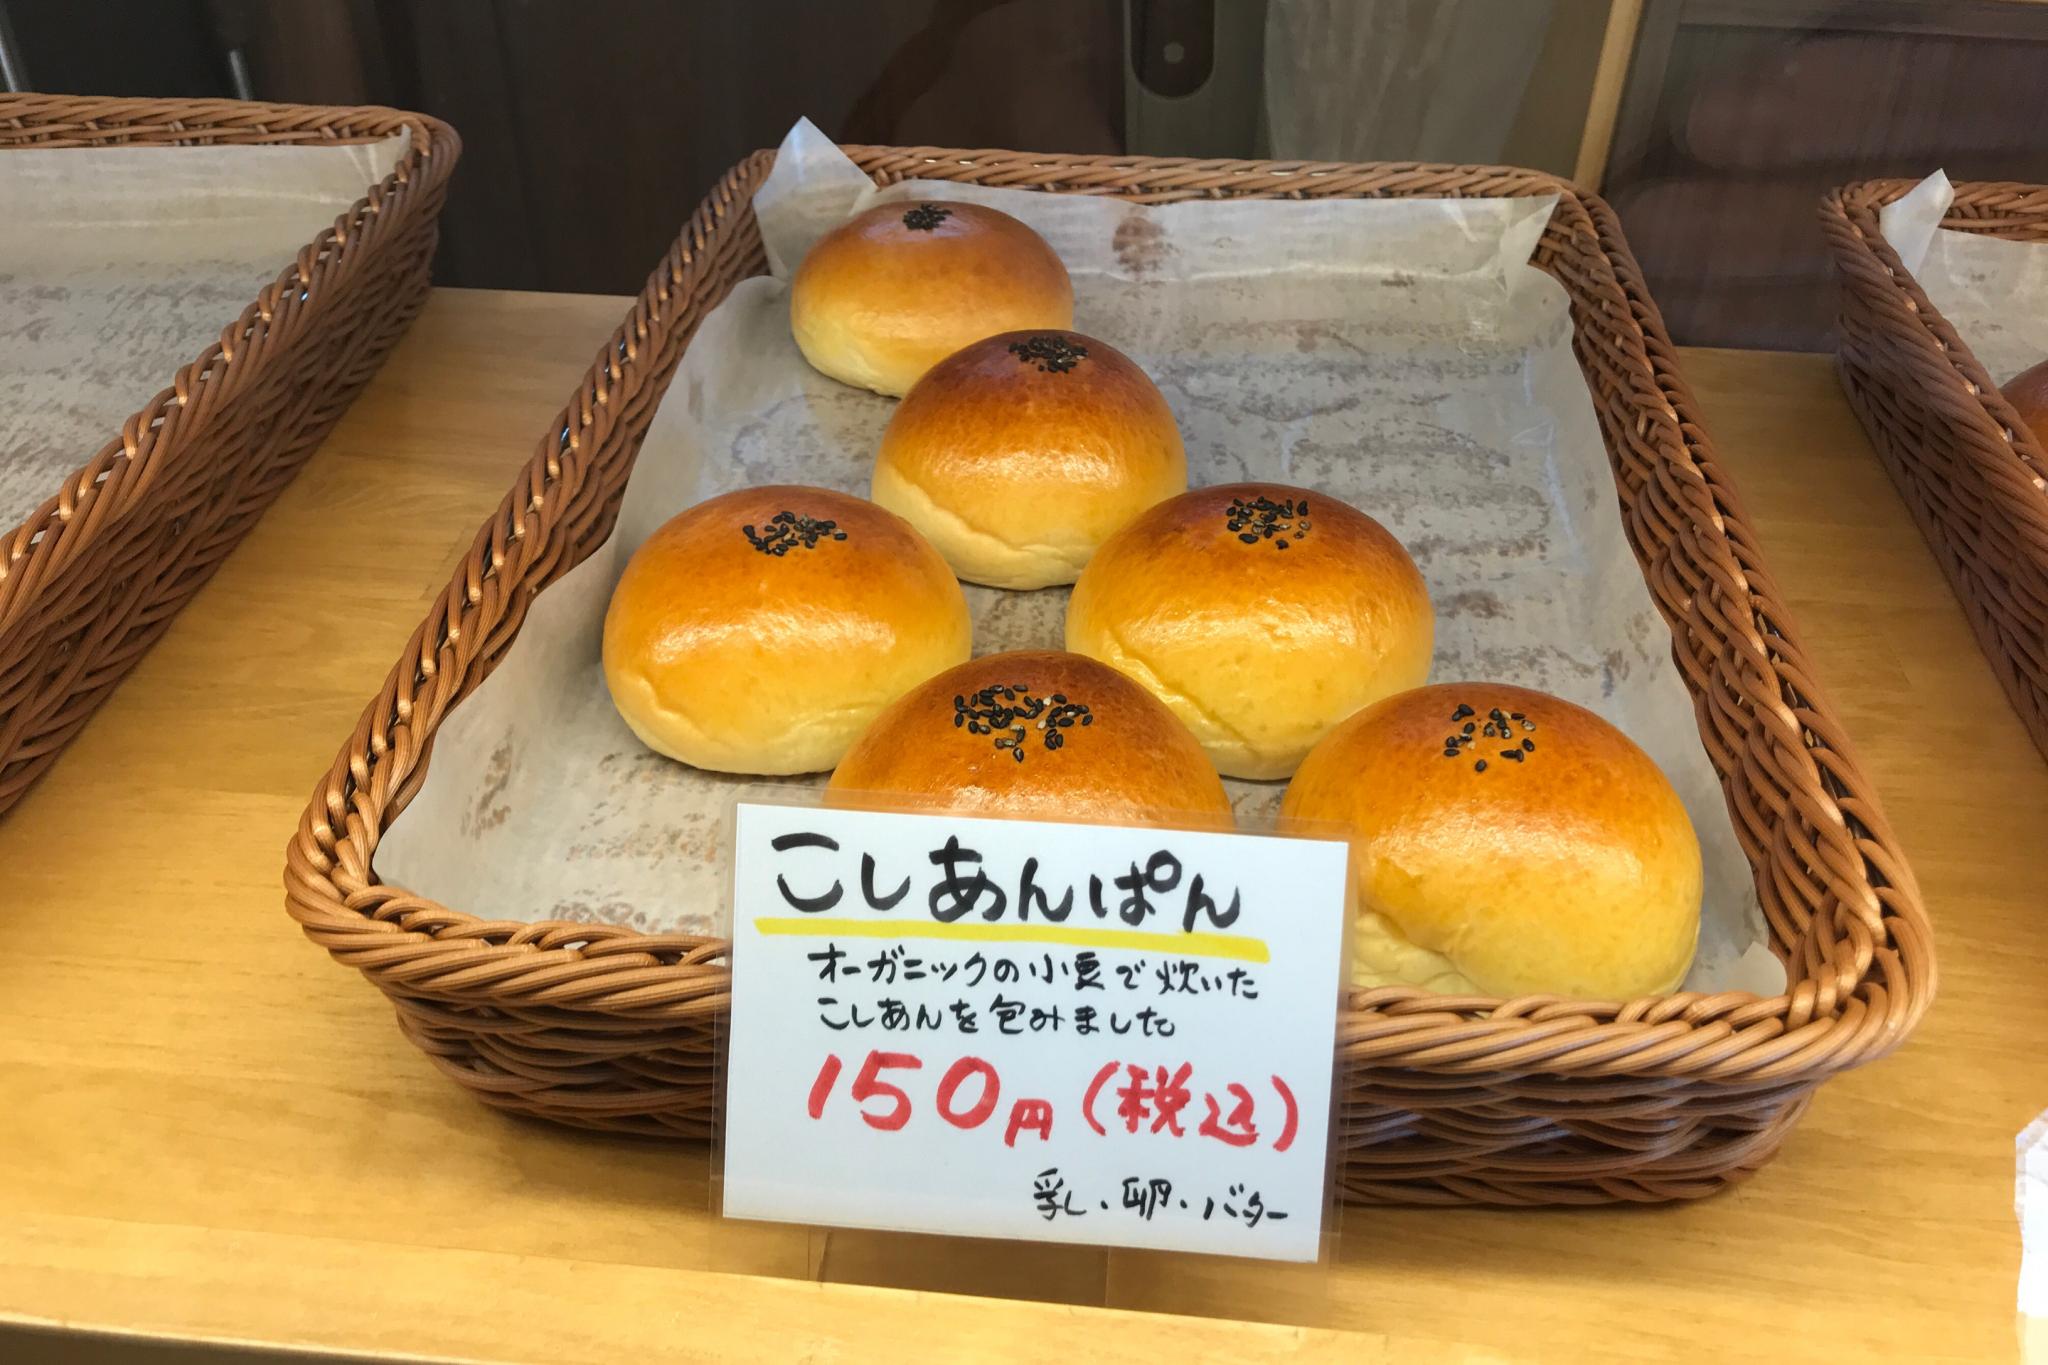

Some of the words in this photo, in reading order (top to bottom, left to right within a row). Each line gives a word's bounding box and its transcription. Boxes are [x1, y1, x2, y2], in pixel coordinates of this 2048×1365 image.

[772, 833, 1241, 933] こしあんぱん
[807, 943, 1259, 999] オーガニックの小豆で炊いた
[818, 996, 1176, 1037] こしあんを包みました
